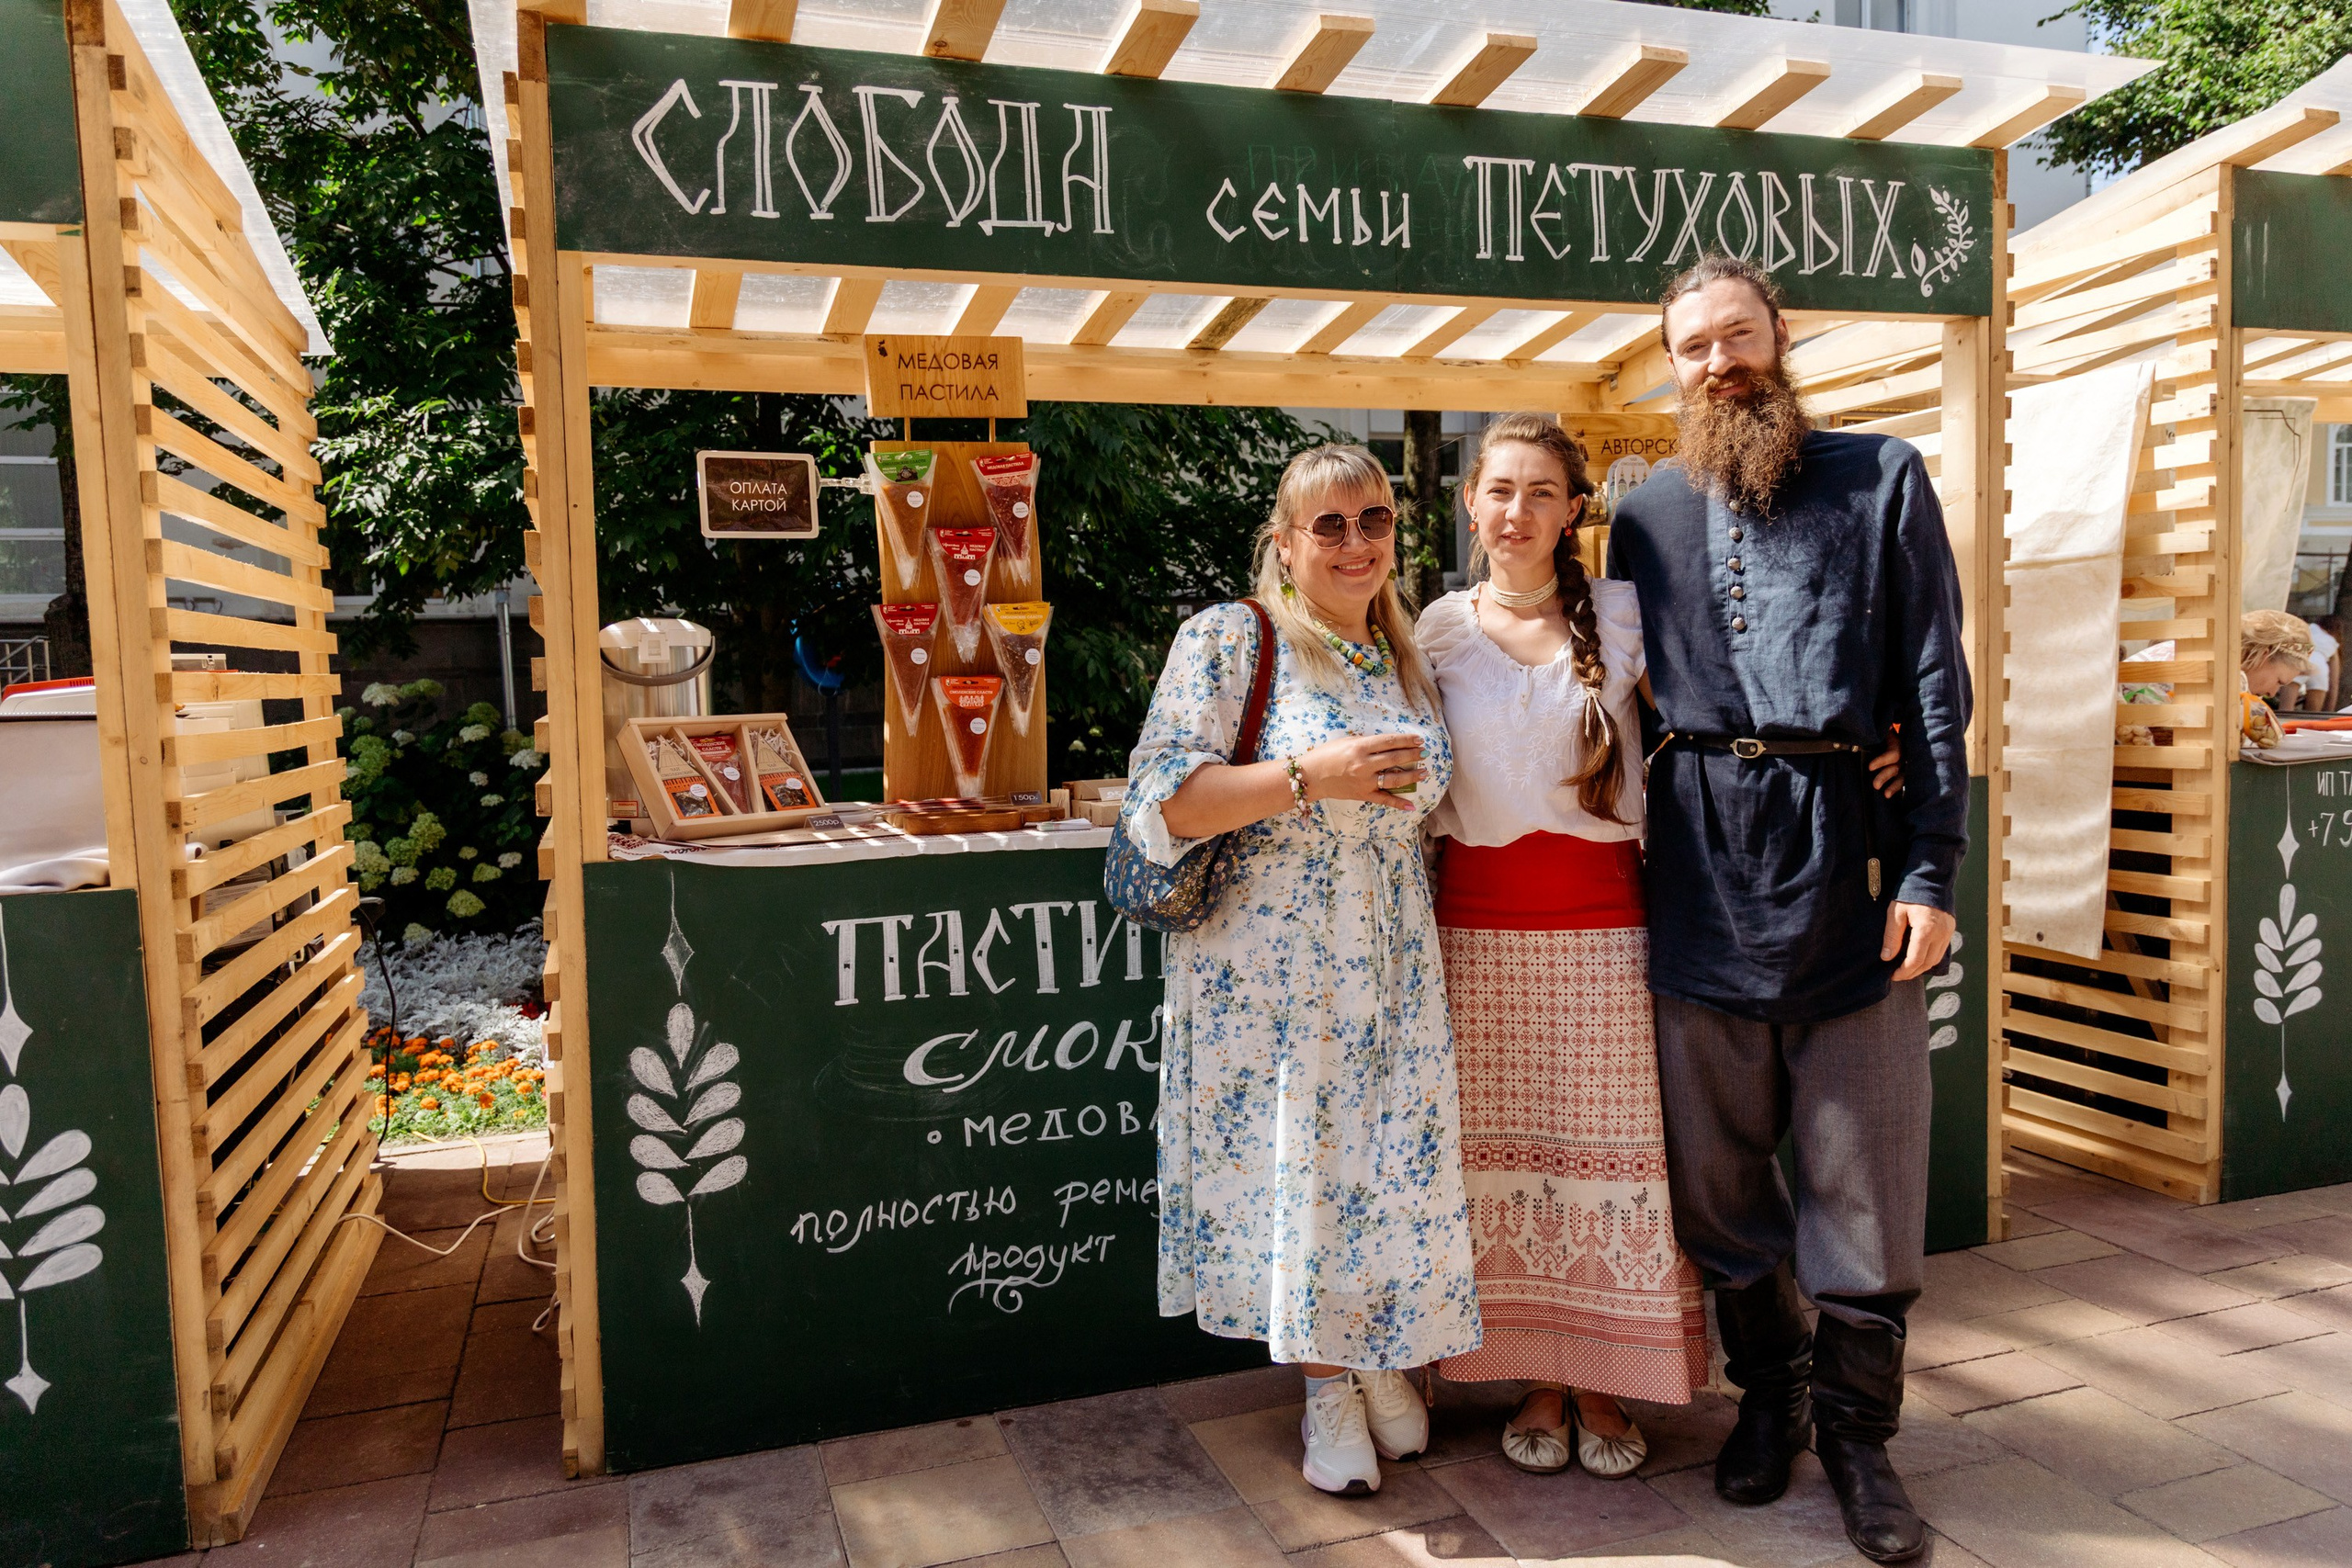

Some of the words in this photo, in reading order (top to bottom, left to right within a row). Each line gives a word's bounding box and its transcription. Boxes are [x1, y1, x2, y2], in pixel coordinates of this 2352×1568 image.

[631, 78, 1114, 237] СЛОБОДА
[1206, 177, 1411, 248] СЕМЬИ
[1462, 155, 1906, 279] ПЕТУХОВЫХ
[898, 353, 999, 371] МЕДОВАЯ
[900, 384, 999, 400] ПАСТИЛА
[729, 481, 787, 495] ОПЛАТА
[731, 497, 786, 512] КАРТОЙ
[2317, 771, 2335, 797] ИП
[2339, 771, 2352, 796] Т
[821, 899, 1168, 1006] ПАСТИ
